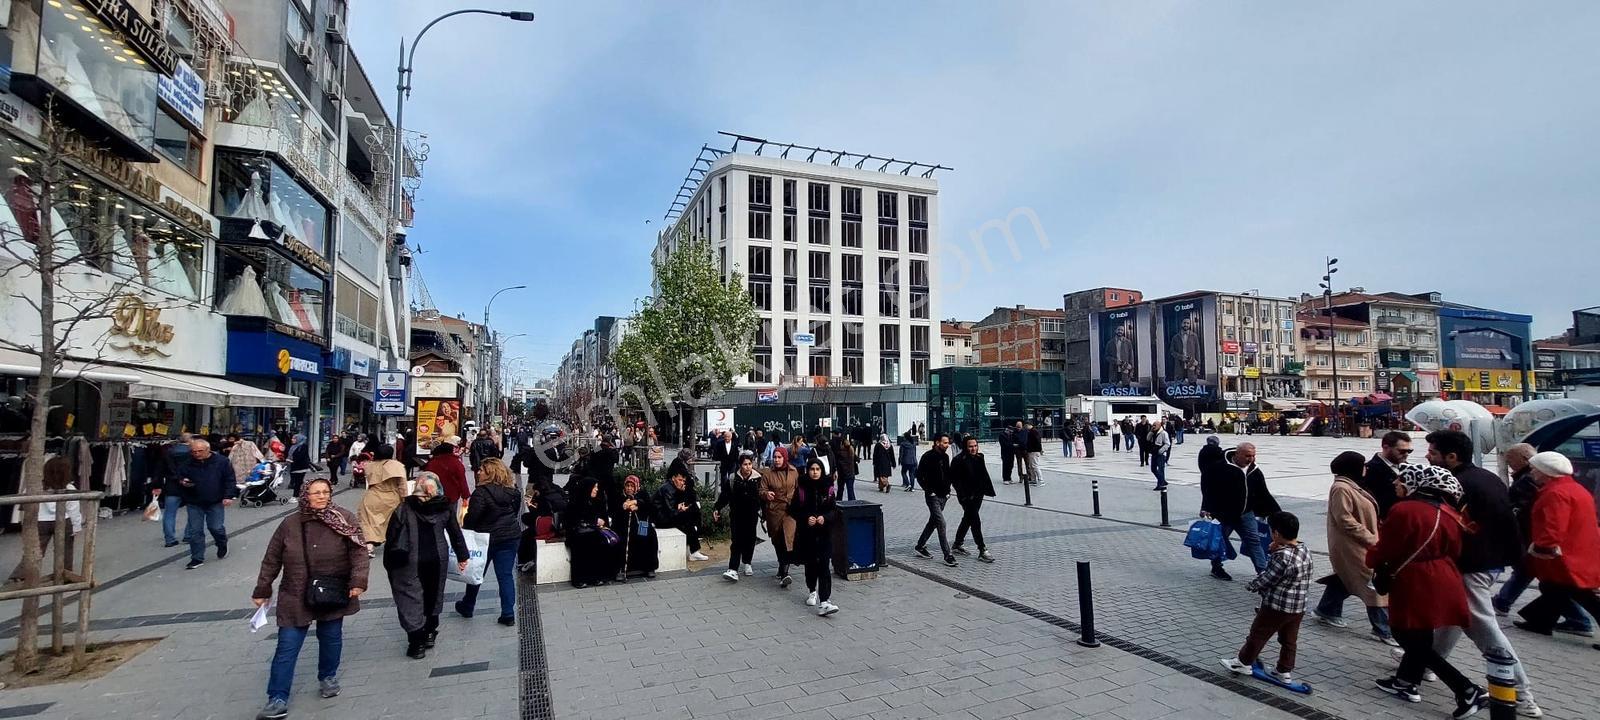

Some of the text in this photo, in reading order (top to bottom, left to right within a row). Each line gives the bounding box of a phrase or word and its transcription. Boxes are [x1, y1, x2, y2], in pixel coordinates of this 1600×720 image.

[130, 17, 179, 72] SULTAN
[1101, 386, 1141, 396] GASSAL
[1166, 384, 1208, 396] GASSAL
